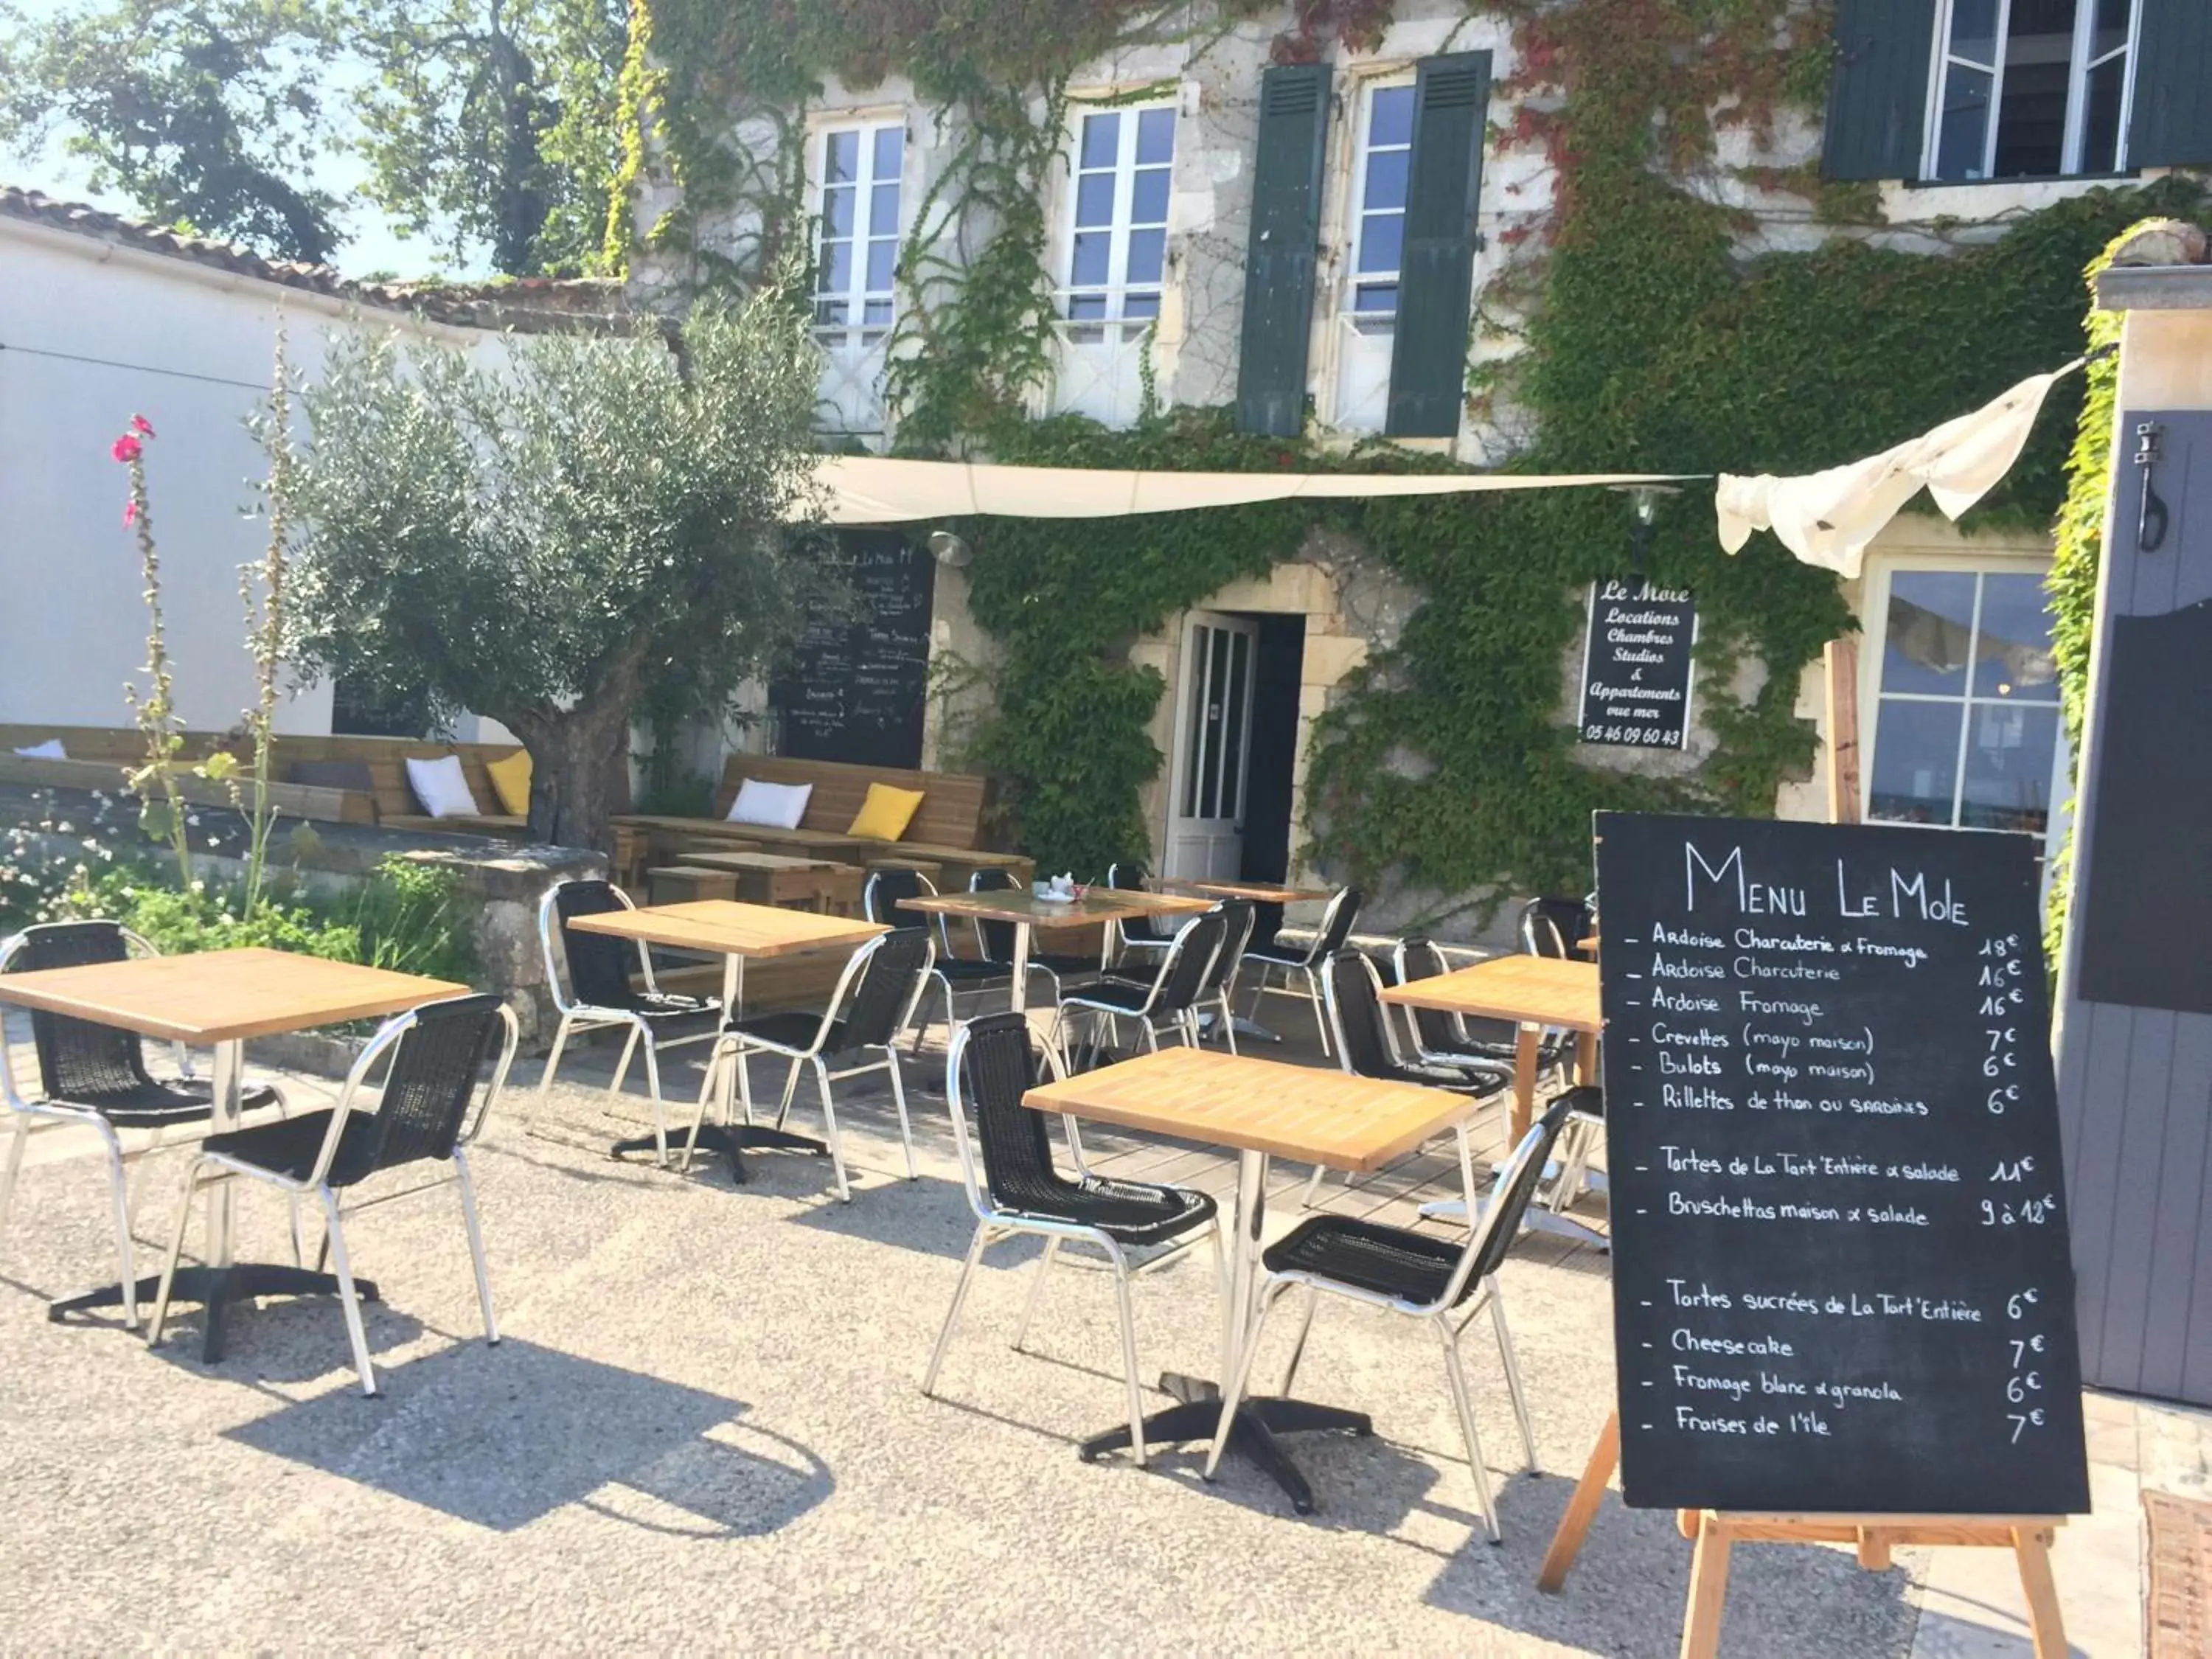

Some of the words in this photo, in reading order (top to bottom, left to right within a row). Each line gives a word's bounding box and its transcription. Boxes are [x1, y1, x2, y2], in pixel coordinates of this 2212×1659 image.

[1600, 580, 1628, 601] Le
[1604, 607, 1680, 626] Locations
[1607, 627, 1674, 645] Chambres
[1613, 647, 1664, 663] Studios
[1630, 667, 1643, 681] &
[1589, 681, 1681, 701] Appartements
[1607, 706, 1631, 717] vue
[1633, 707, 1661, 719] mer
[1586, 725, 1604, 740] 05
[1604, 725, 1622, 741] 46
[1623, 726, 1642, 744] 09
[1642, 728, 1660, 744] 60
[1661, 729, 1680, 745] 43
[1685, 841, 1806, 917] MENU
[1837, 858, 1880, 917] LE
[1734, 928, 1835, 953] Charcuterie
[1857, 937, 1929, 969] Fromage
[1733, 956, 1842, 981] Charcuterie
[1651, 985, 1721, 1012] Ardoise
[1739, 990, 1825, 1026] Fromage
[1651, 1022, 1730, 1048] Crevettes
[1742, 1022, 1801, 1060] (mayo
[1809, 1026, 1874, 1055] maison)
[1659, 1051, 1722, 1075] Bulots
[1745, 1052, 1799, 1084] (mayo
[1808, 1061, 1876, 1085] maison)
[1663, 1082, 1735, 1110] Rillettes
[1747, 1090, 1769, 1110] de
[1773, 1089, 1813, 1110] thon
[1659, 1145, 1722, 1173] Tartes
[1728, 1156, 1749, 1176] de
[1754, 1155, 1776, 1175] La
[1902, 1161, 1961, 1182] salade
[1668, 1191, 1776, 1220] Bruschettas
[1780, 1200, 1840, 1221] maison
[1866, 1204, 1930, 1226] salade
[1980, 1199, 1995, 1225] 9
[2001, 1203, 2016, 1225] à
[1666, 1279, 1732, 1309] Tartes
[1742, 1291, 1819, 1315] sucrées
[1825, 1295, 1846, 1314] de
[1851, 1293, 1875, 1316] La
[1671, 1328, 1794, 1357] Cheesecake
[1672, 1364, 1751, 1402] Fromage
[1760, 1371, 1807, 1396] blanc
[1830, 1381, 1903, 1409] granola
[1674, 1405, 1747, 1435] Fraises
[1753, 1415, 1780, 1435] de
